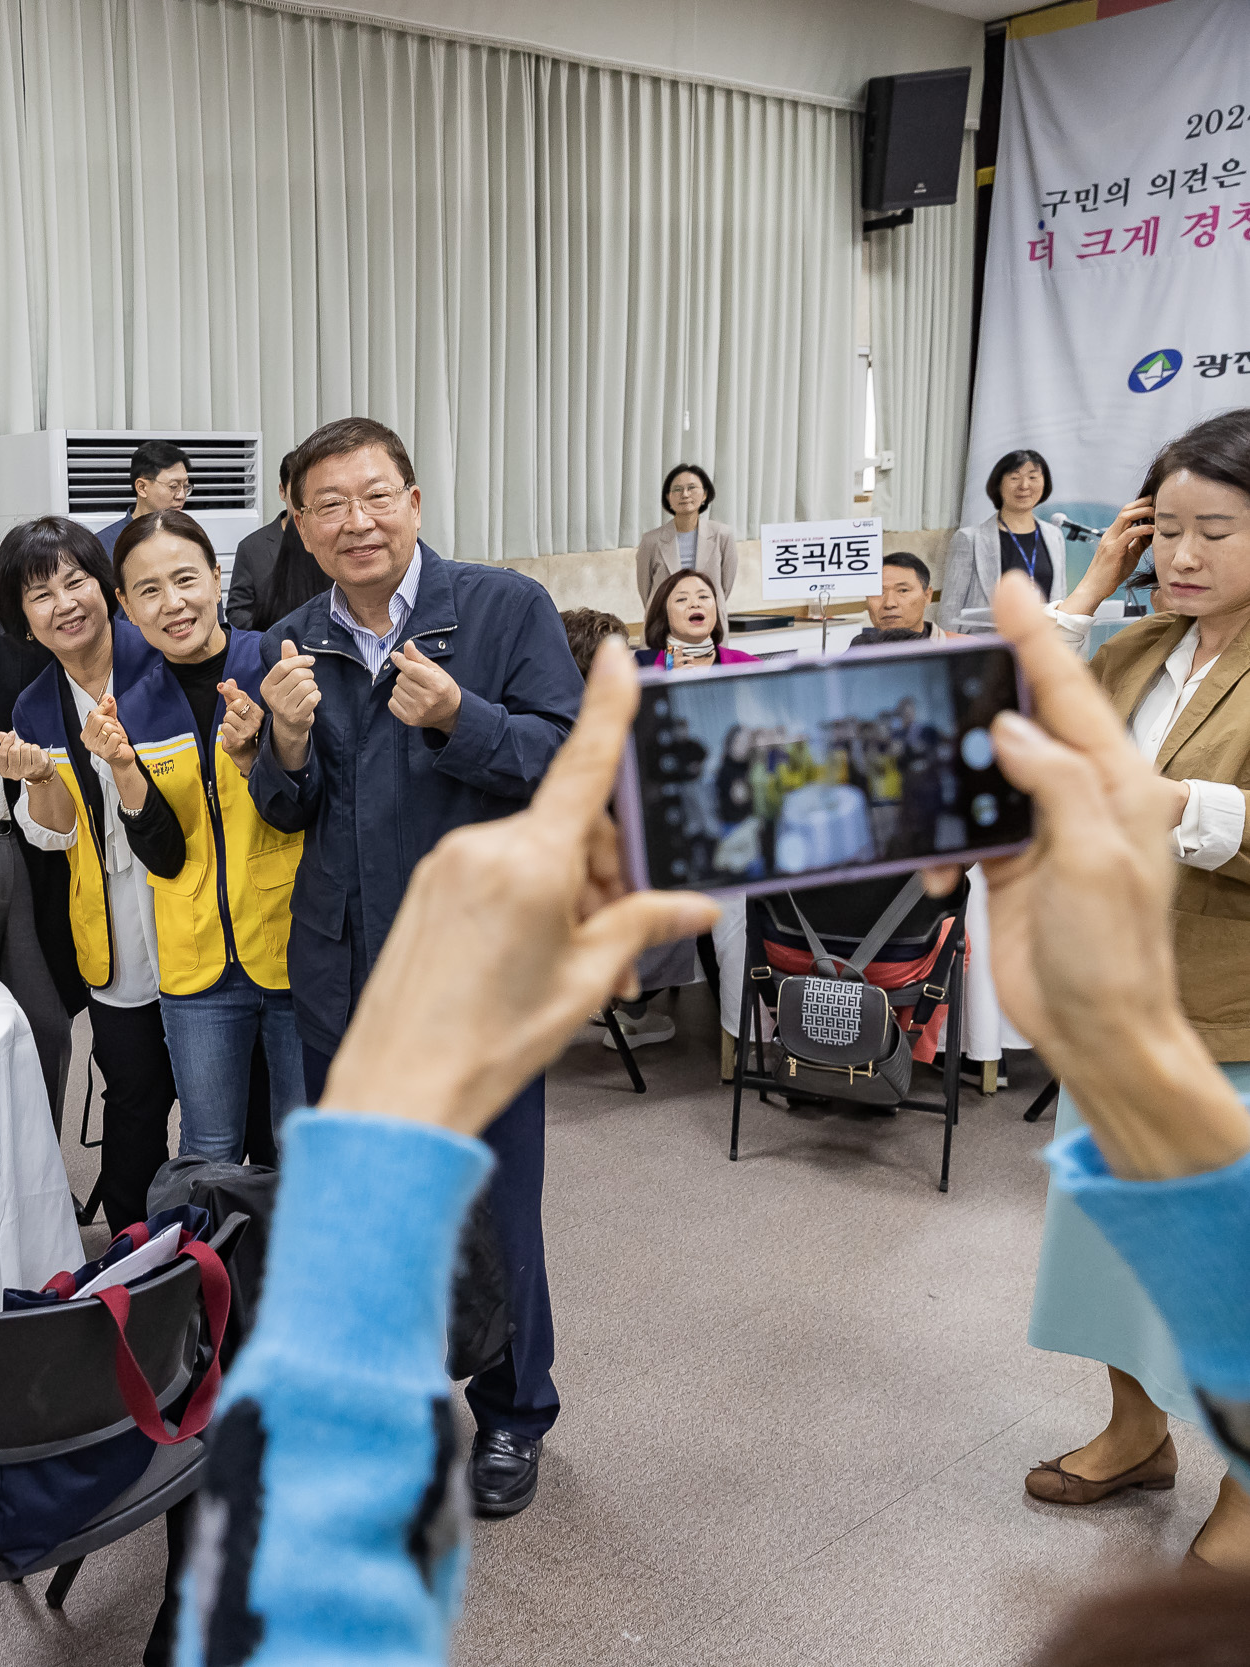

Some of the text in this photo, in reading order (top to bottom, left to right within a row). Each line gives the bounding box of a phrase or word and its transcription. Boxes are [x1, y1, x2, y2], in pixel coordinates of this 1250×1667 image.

[1185, 104, 1250, 140] 202
[1042, 157, 1247, 218] 구민의 의견은
[1027, 231, 1054, 270] 더
[1076, 216, 1160, 259] 크게
[775, 540, 871, 575] 중곡4동
